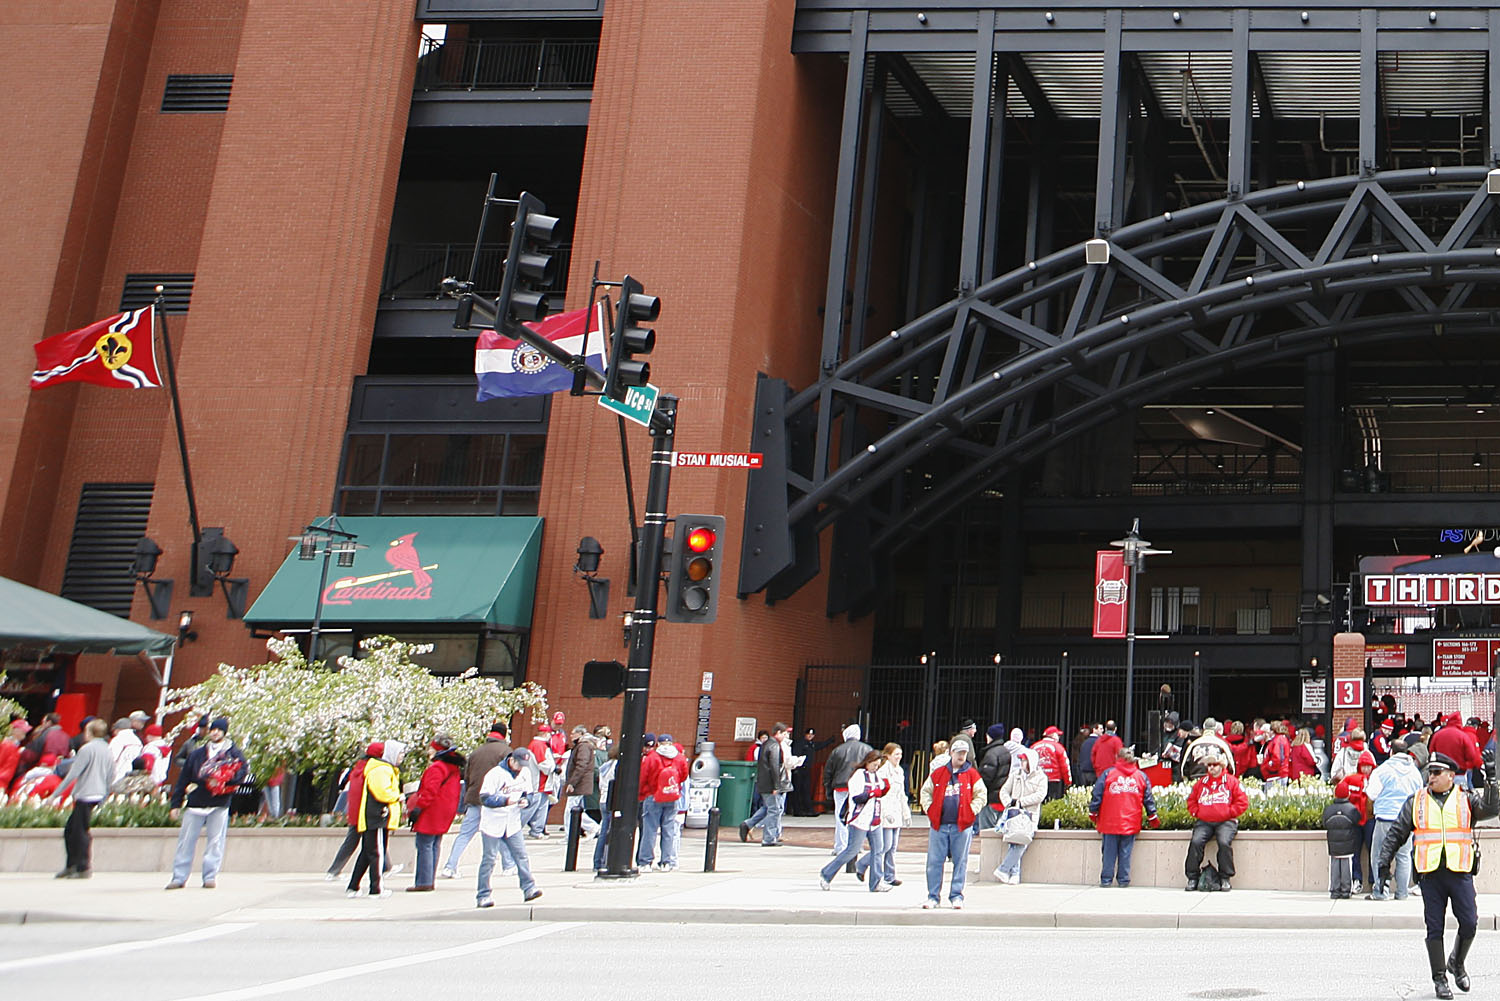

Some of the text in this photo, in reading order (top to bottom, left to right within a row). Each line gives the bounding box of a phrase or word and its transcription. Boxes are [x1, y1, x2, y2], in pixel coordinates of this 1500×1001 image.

[678, 453, 706, 466] STAN
[709, 454, 750, 467] MUSIAL
[321, 576, 433, 605] Cardinals
[1343, 682, 1354, 704] 3
